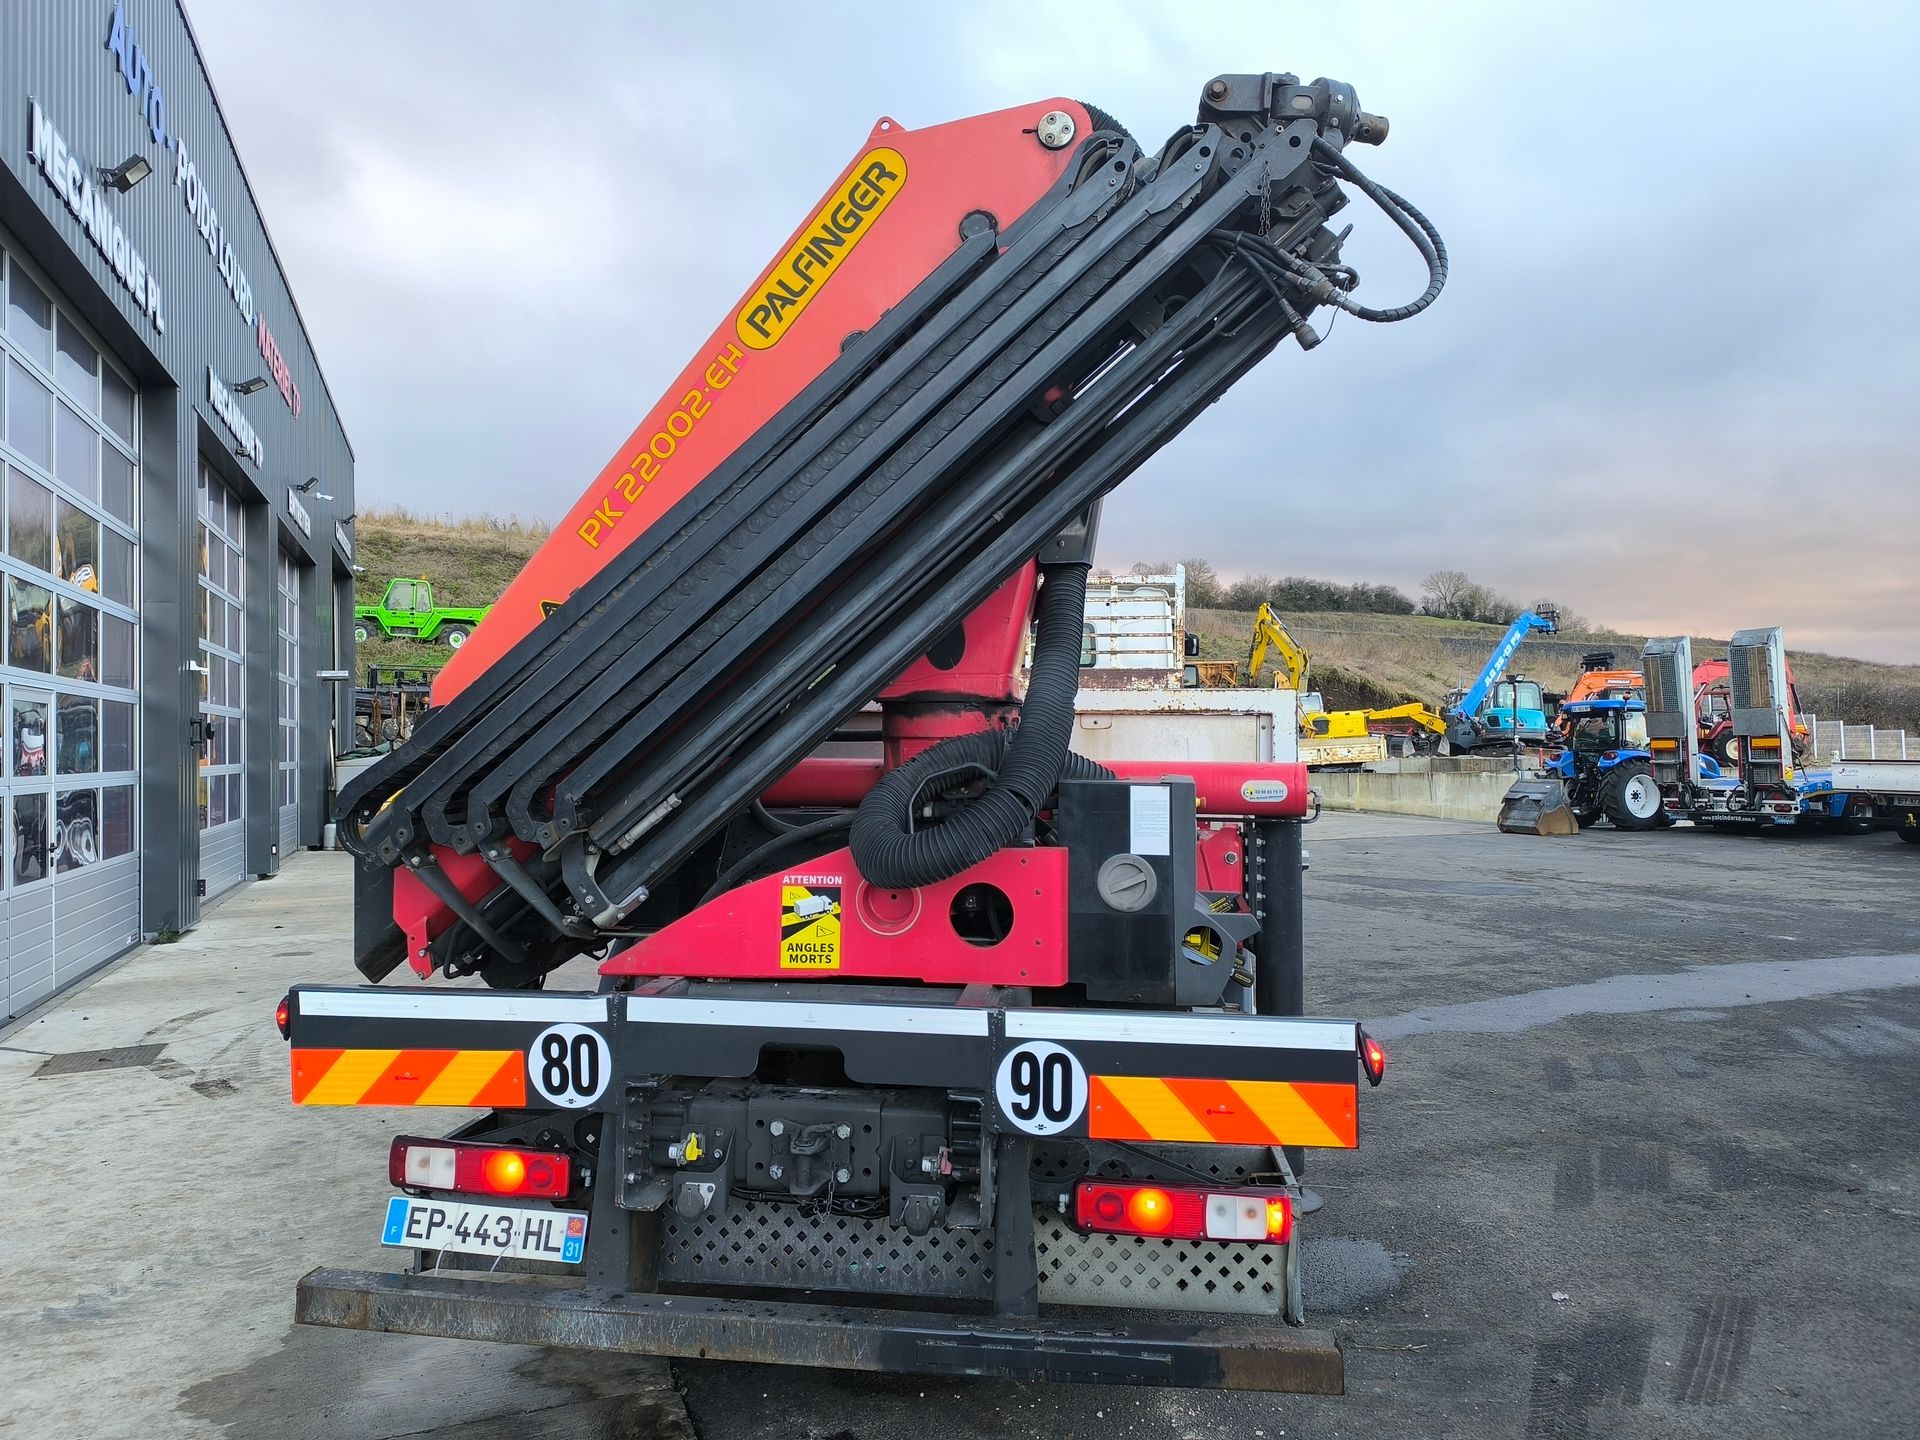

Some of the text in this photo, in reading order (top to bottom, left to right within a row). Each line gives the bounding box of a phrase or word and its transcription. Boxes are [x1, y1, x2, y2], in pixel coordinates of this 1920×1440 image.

[33, 99, 165, 334] MECANIQUE PL
[109, 1, 165, 145] AUTO
[176, 136, 218, 256] POIDS
[218, 225, 253, 326] LOURD
[258, 312, 291, 408] MATERIEL
[291, 381, 301, 419] TP
[745, 160, 898, 339] PALFINGER
[209, 366, 256, 461] MECANIQUE
[577, 497, 624, 549] PK
[782, 875, 842, 884] ATTENTION
[787, 943, 834, 953] ANGLES
[789, 954, 832, 964] MORTS
[541, 1033, 599, 1097] 80
[1010, 1051, 1073, 1123] 90
[390, 1226, 398, 1235] F
[565, 1242, 581, 1258] 31
